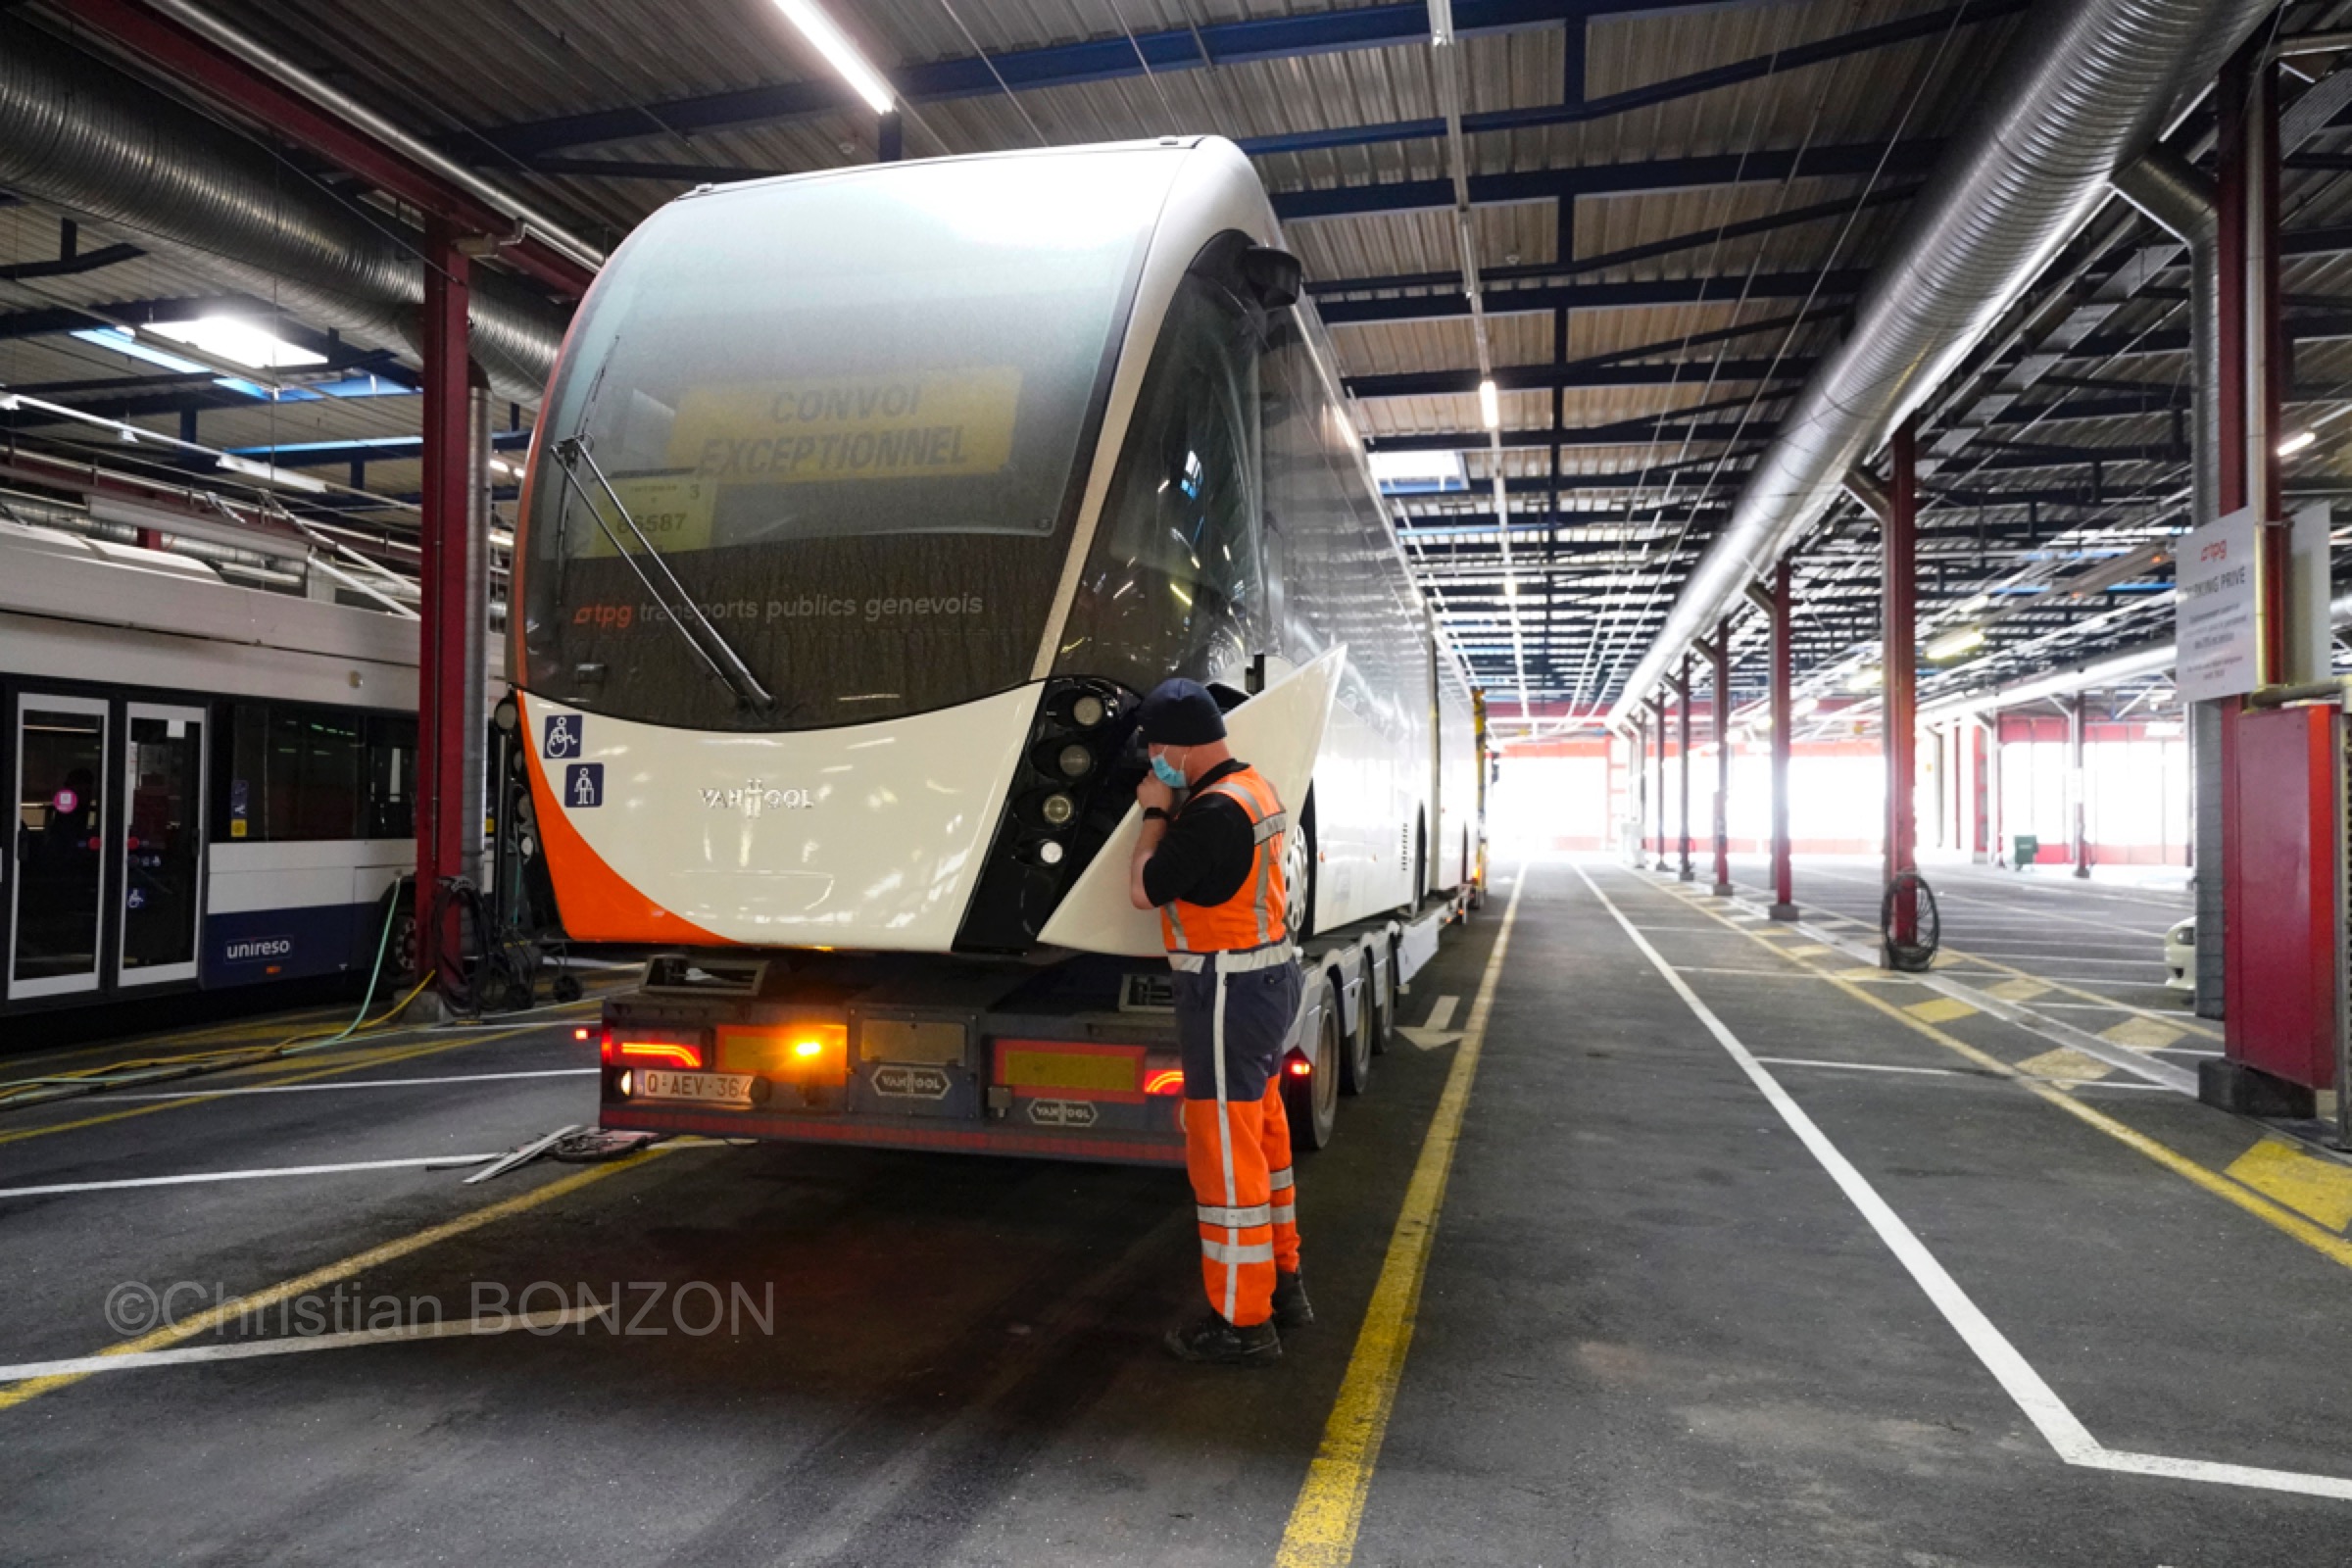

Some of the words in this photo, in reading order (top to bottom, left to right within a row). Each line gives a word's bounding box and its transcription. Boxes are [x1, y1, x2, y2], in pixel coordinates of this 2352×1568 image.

[770, 383, 920, 424] CONVOI
[696, 424, 968, 480] EXCEPTIONNEL
[689, 483, 701, 501] 3
[2184, 575, 2220, 600] RKING
[594, 603, 633, 628] tpg
[640, 597, 760, 625] transports
[765, 593, 858, 624] publics
[864, 592, 984, 622] genevois
[226, 939, 291, 959] unireso
